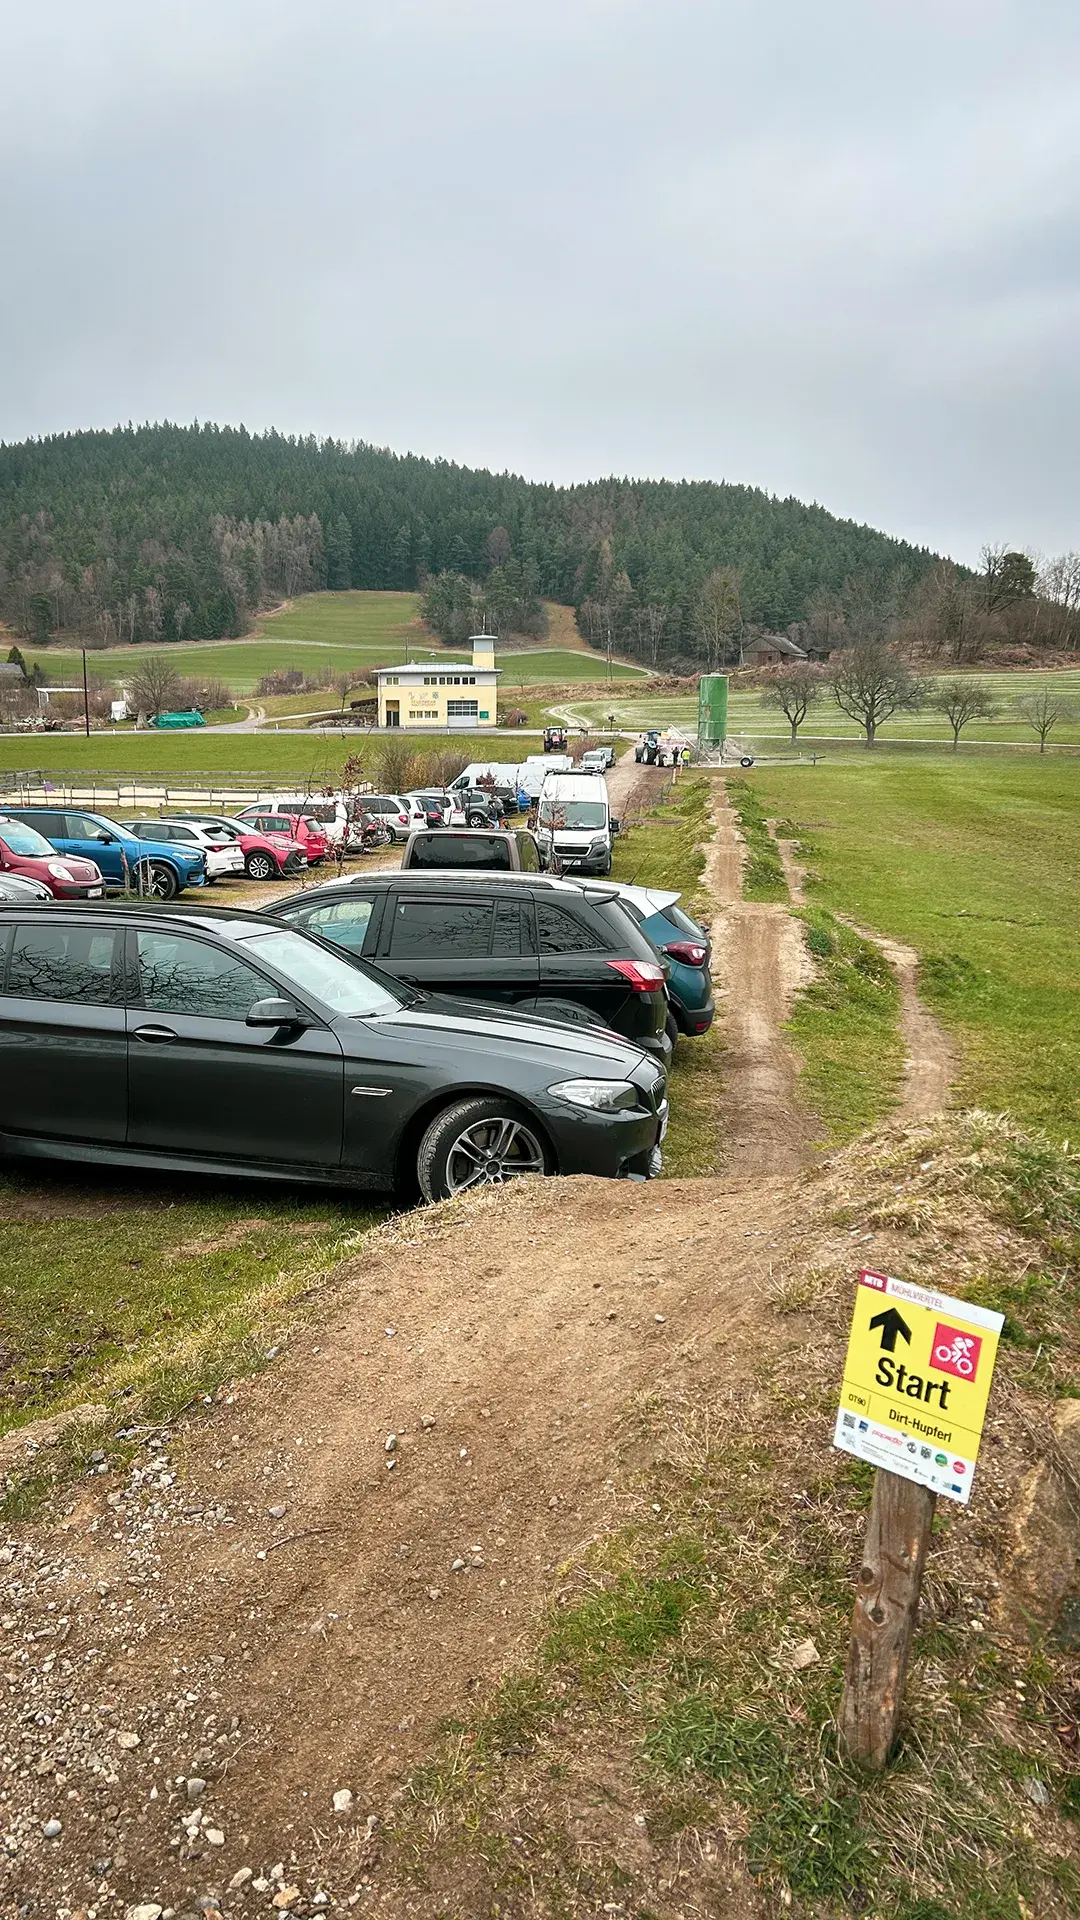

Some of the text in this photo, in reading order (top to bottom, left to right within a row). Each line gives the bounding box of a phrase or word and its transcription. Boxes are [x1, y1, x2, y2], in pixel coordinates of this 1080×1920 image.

[864, 1274, 944, 1308] MTB MÜHLVIERTEL
[875, 1357, 951, 1409] Start
[889, 1409, 952, 1442] Dirt-Hupferl
